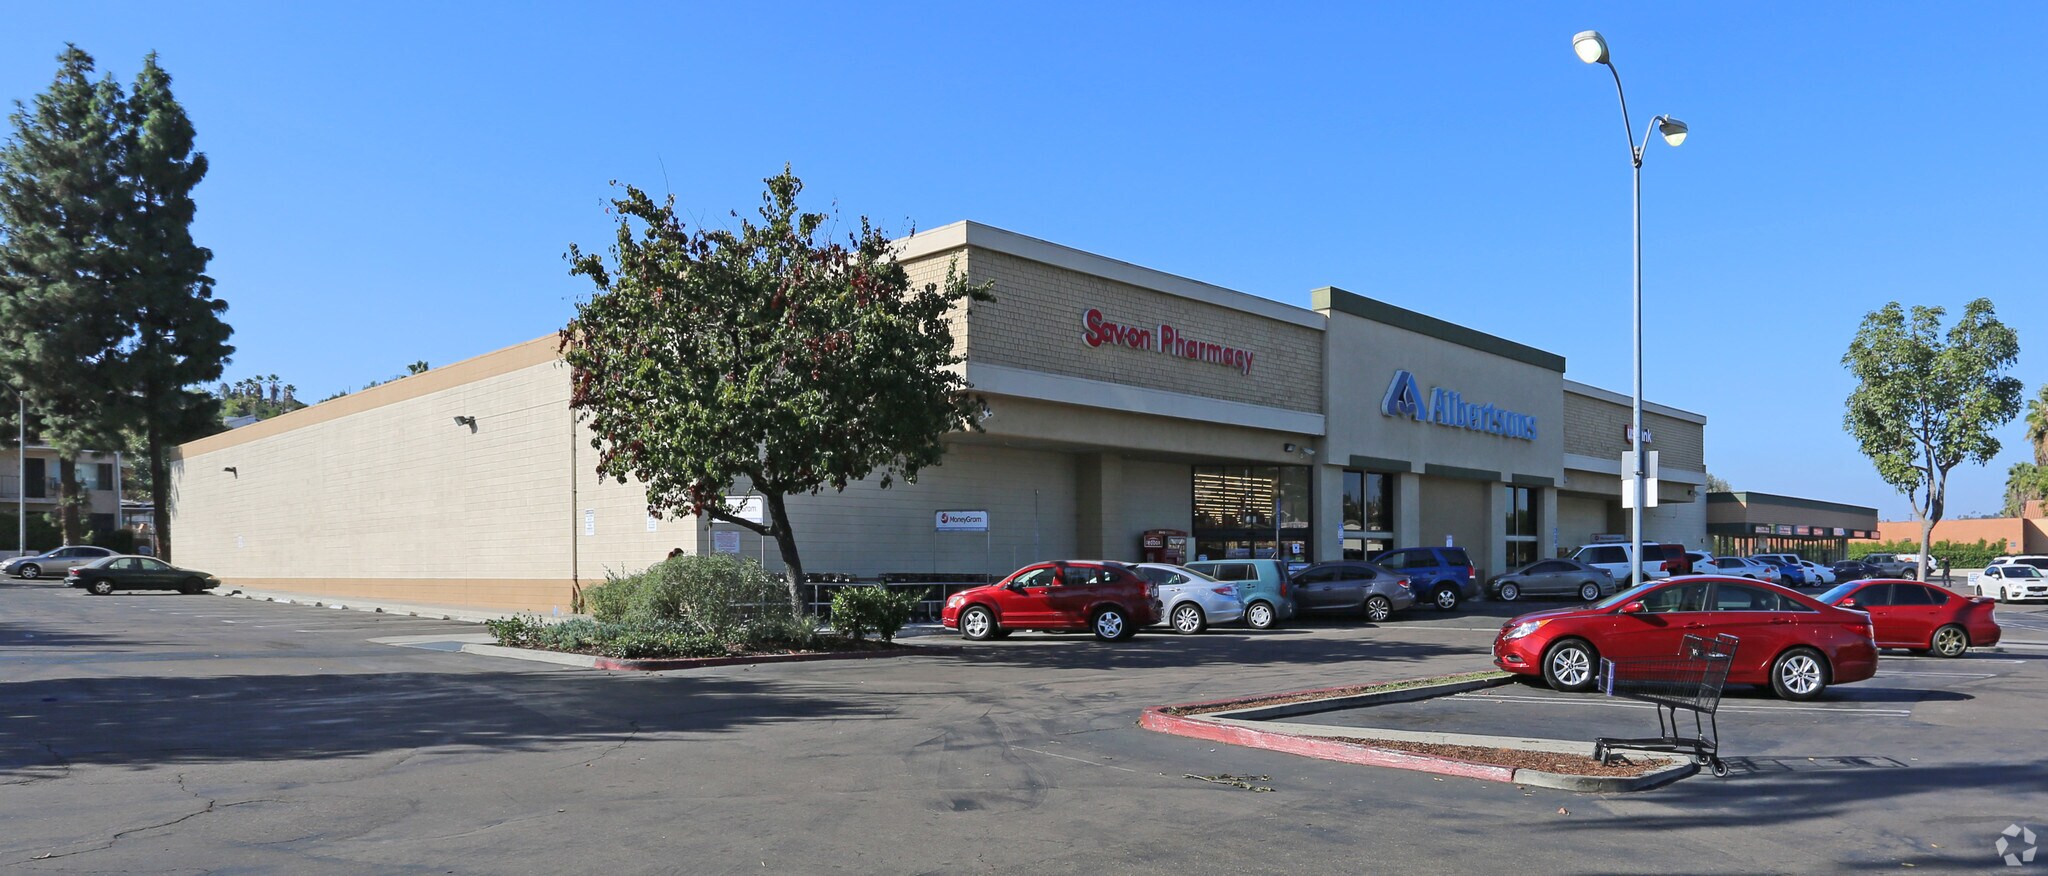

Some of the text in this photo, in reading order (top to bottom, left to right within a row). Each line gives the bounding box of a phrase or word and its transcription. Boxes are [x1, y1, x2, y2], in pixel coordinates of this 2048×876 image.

[1157, 324, 1254, 376] Pharmacy
[1427, 386, 1537, 441] Albertsons
[949, 515, 982, 525] MoneyGram
